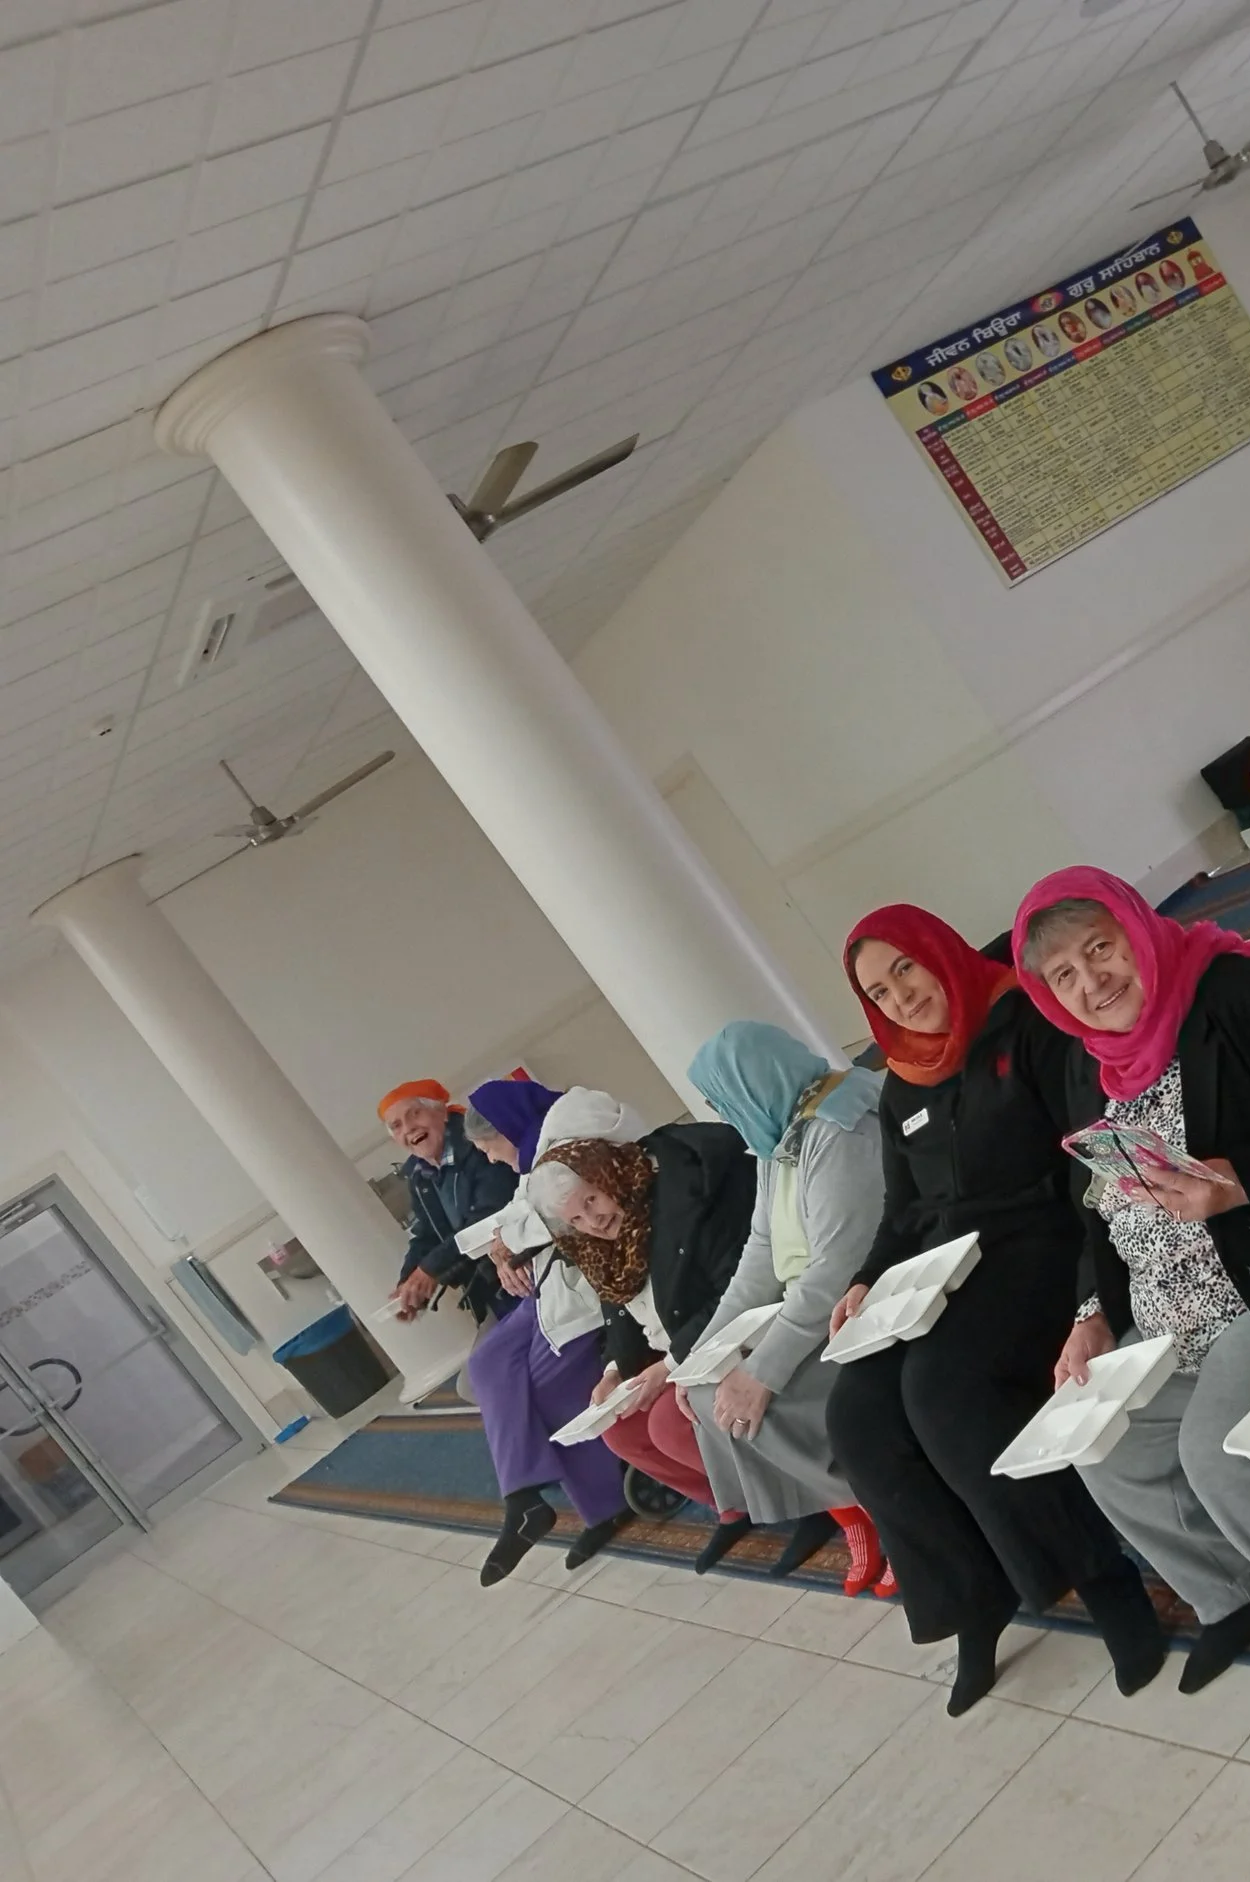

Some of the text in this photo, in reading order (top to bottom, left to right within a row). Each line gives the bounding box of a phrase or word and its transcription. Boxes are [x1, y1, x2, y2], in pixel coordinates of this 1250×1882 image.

[925, 336, 971, 368] ਜੀਵਨ
[1067, 275, 1095, 298] ਗੁਰੂ
[1098, 242, 1161, 281] ਸਾਹਿਬਾਨ
